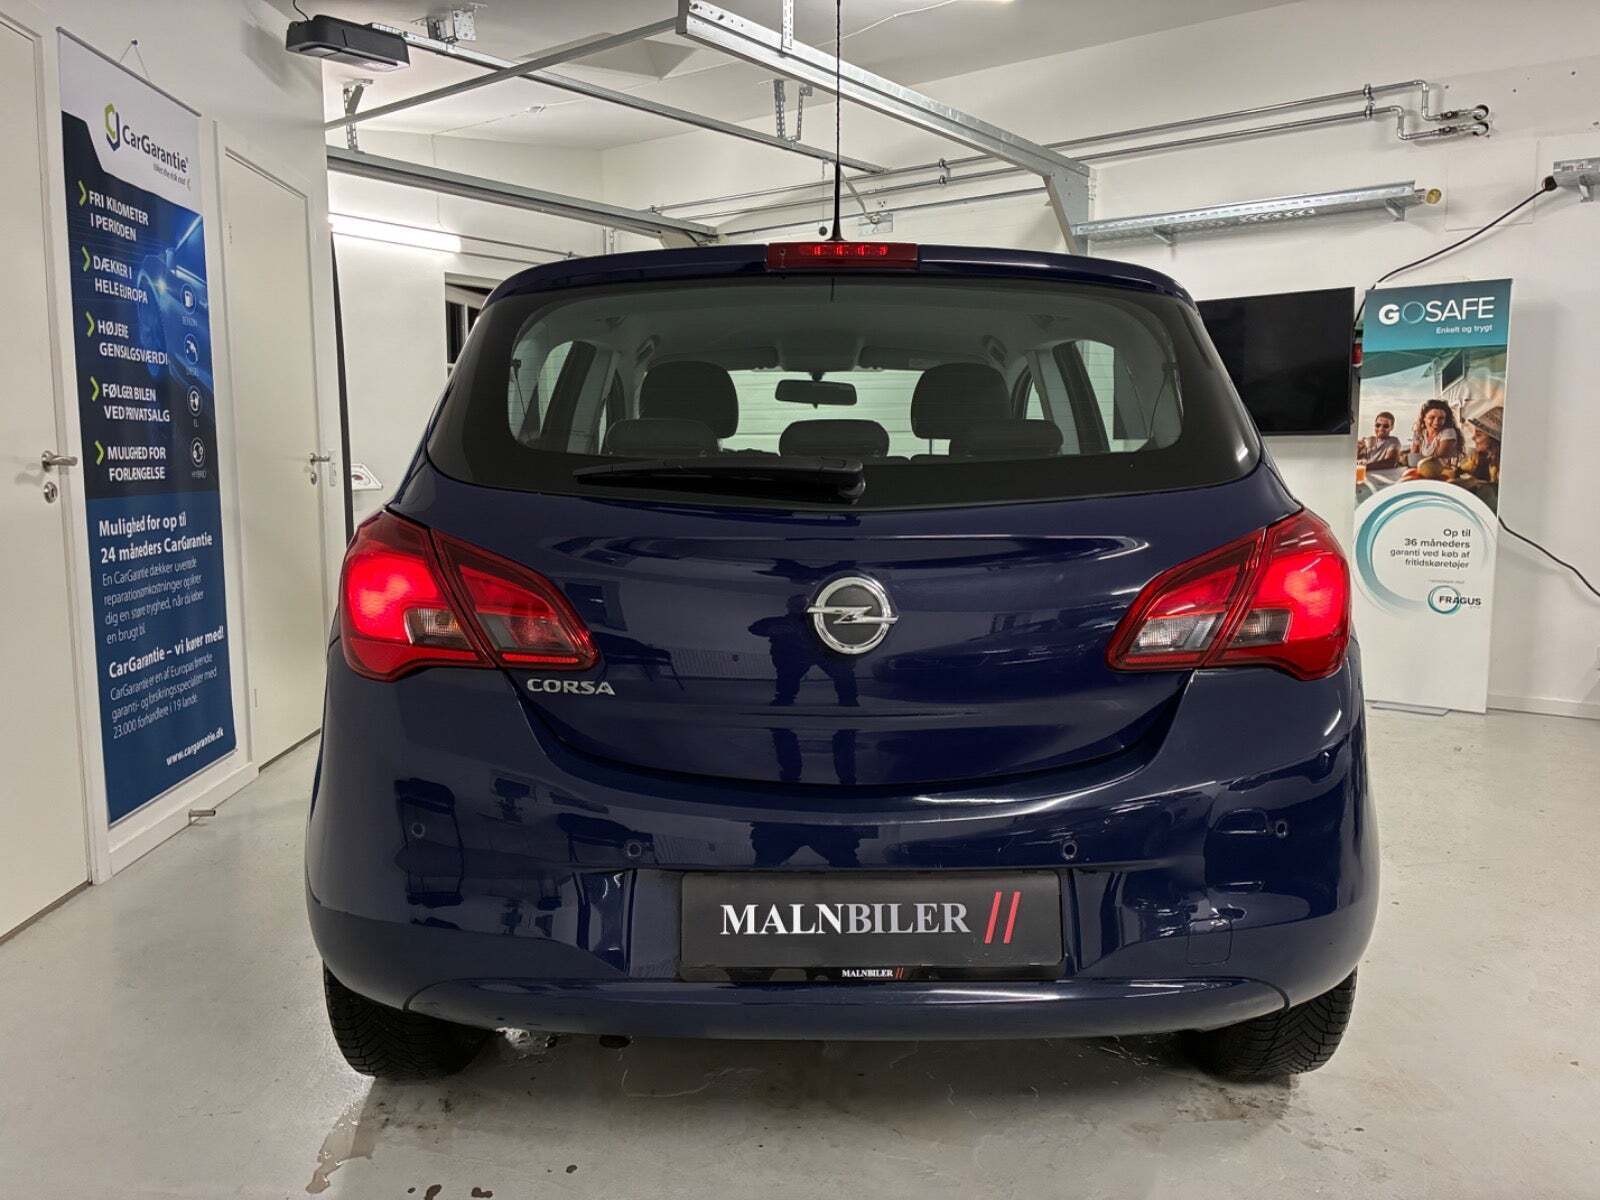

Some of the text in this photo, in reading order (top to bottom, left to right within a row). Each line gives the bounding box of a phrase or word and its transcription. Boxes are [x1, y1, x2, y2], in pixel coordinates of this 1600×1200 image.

[89, 191, 148, 225] FRI KILOMETER
[90, 213, 136, 241] I PERIODEN
[93, 255, 128, 277] DÆKKER
[95, 278, 148, 304] HELE EUROPA
[1378, 297, 1496, 325] GOSAFE
[98, 320, 129, 338] HØJERE
[1436, 324, 1494, 335] Enkelt og trygt
[100, 342, 168, 365] GENSALGSVÆRDI
[102, 384, 156, 402] FØLGER BILEN
[104, 406, 170, 422] VED PRIVATSALG
[108, 446, 166, 460] MULIGHED FOR
[109, 466, 166, 482] FORLÆNGELSE
[99, 511, 187, 538] Mulighed for op til
[1444, 528, 1472, 538] Op til
[101, 532, 213, 564] 24 måneders CarGarantie
[1404, 538, 1471, 549] 36 måneders
[1390, 548, 1471, 559] garanti ved køb af
[1405, 558, 1470, 570] fritidskøretøjer
[102, 572, 112, 586] En
[1439, 596, 1482, 606] FRAGUS
[105, 611, 118, 626] dig
[106, 633, 117, 644] en
[109, 646, 165, 678] CarGarantie
[174, 640, 184, 656] vi
[186, 636, 203, 652] kører
[205, 626, 224, 644] med!
[527, 678, 616, 696] CORSA
[113, 719, 136, 740] 23.000
[166, 726, 224, 766] www.cargarantie.dk
[719, 902, 971, 936] MALNBILER
[842, 968, 894, 978] MALNBILER
